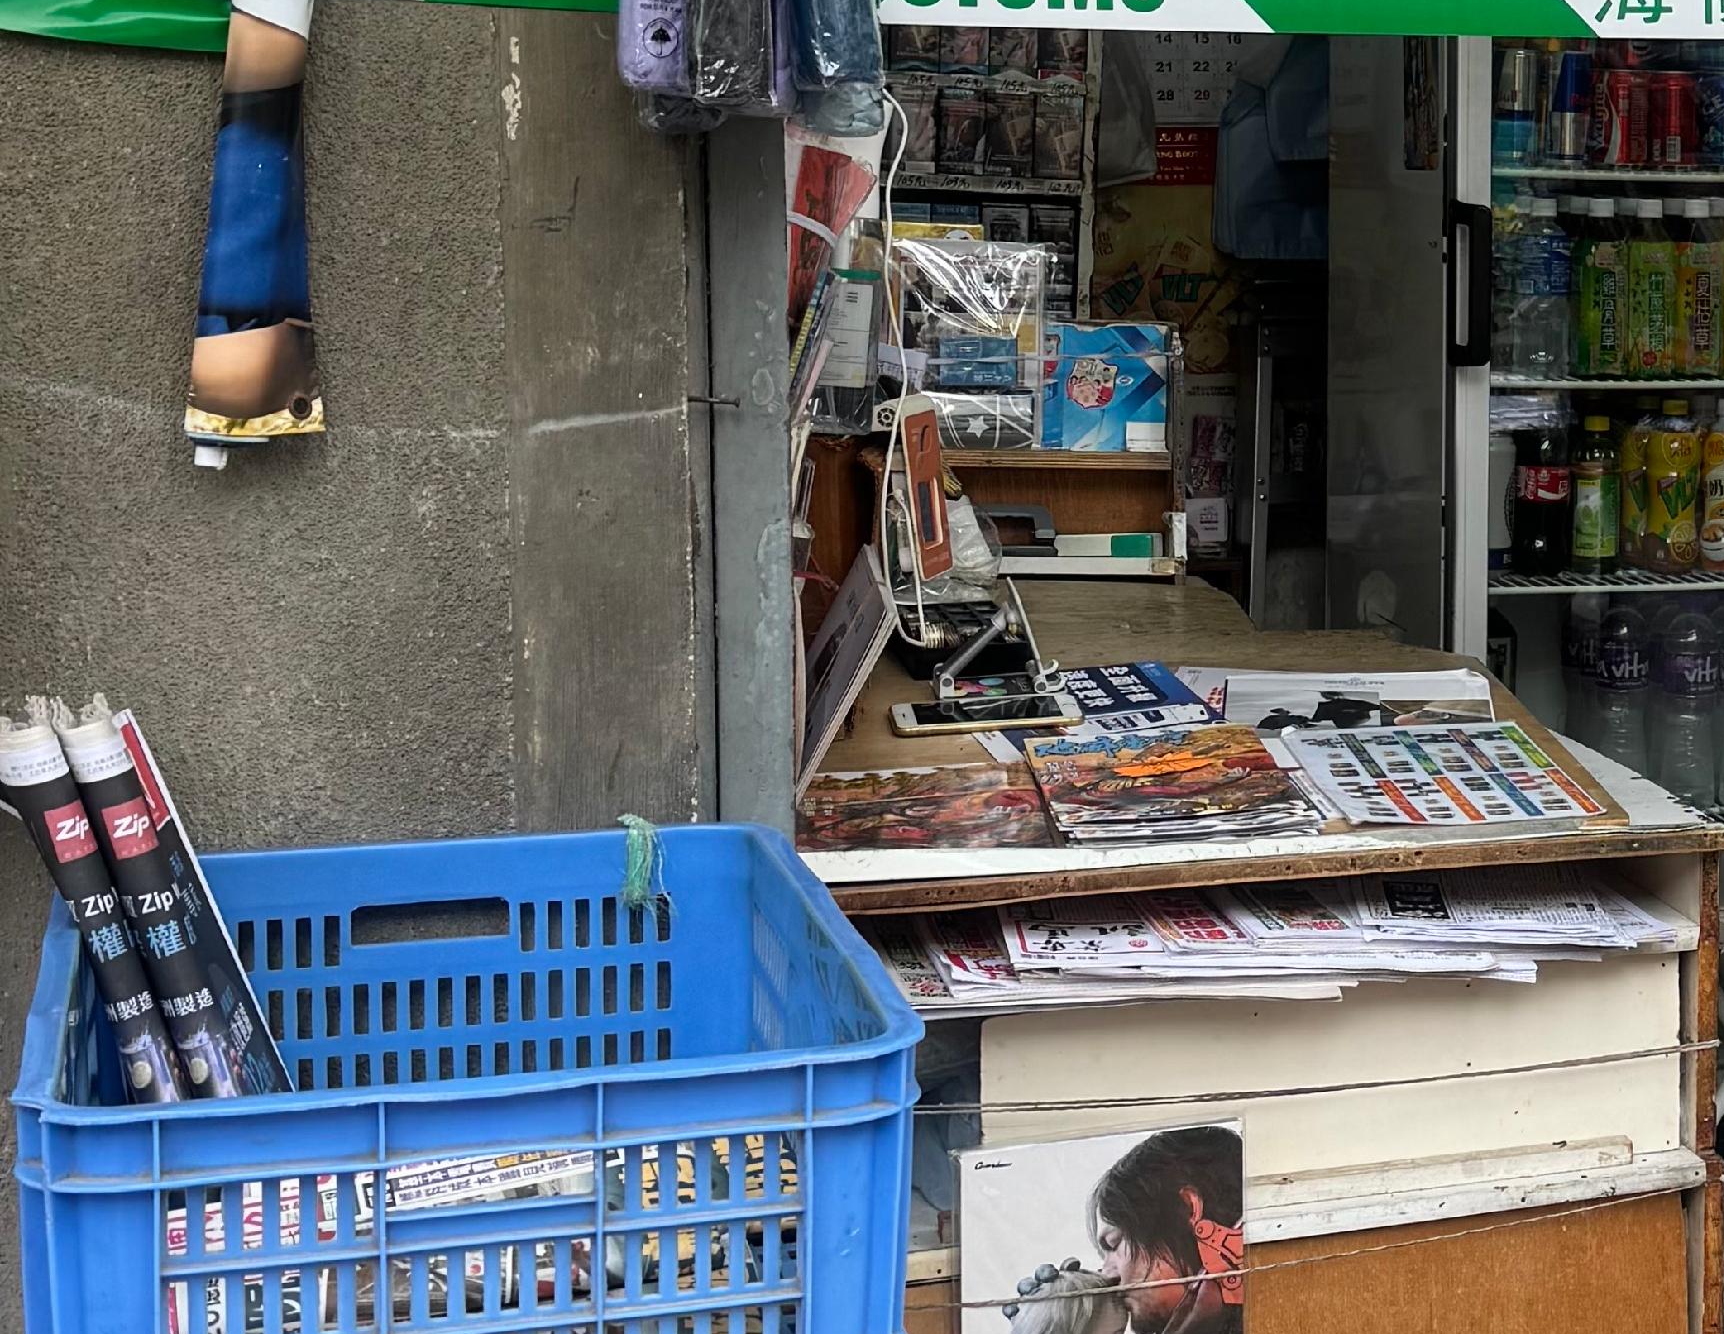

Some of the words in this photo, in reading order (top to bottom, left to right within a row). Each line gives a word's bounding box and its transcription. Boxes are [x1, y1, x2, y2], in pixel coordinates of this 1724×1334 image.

[1155, 61, 1174, 74] 21
[1192, 61, 1211, 74] 22
[1156, 89, 1175, 102] 28
[56, 815, 90, 841] Zip
[113, 812, 150, 839] Zip
